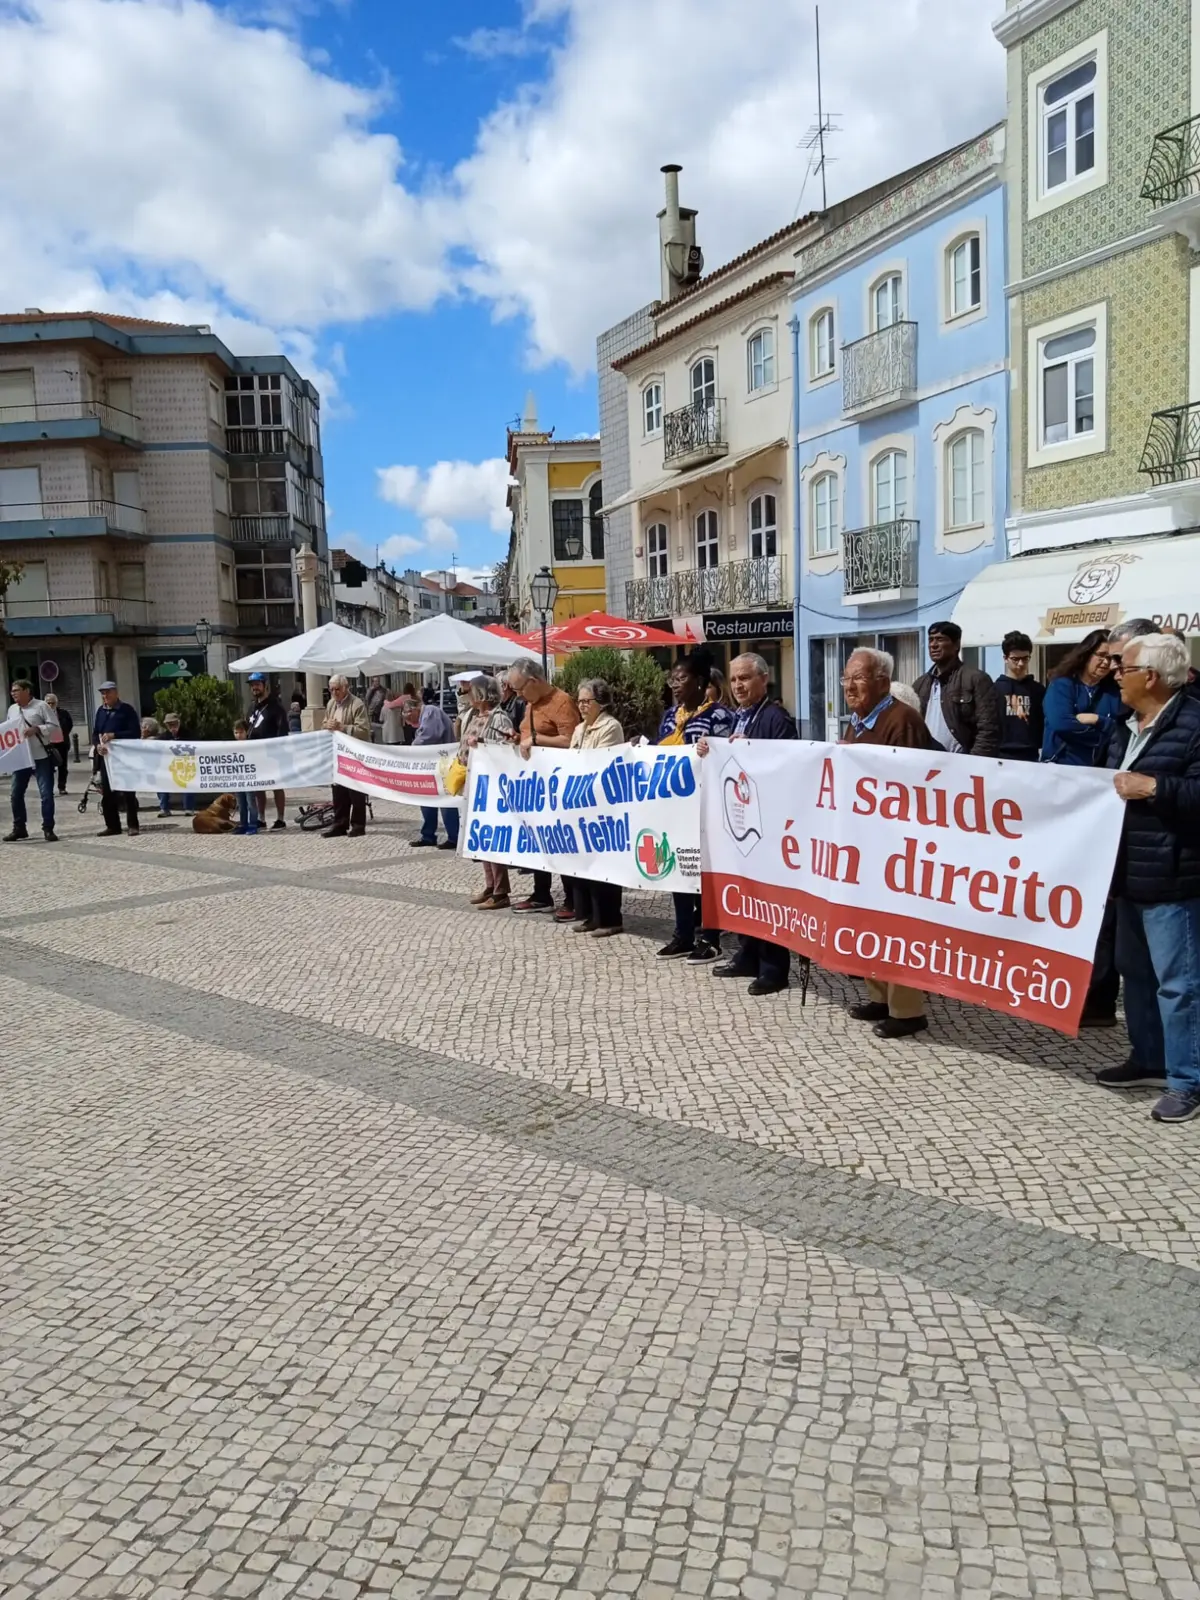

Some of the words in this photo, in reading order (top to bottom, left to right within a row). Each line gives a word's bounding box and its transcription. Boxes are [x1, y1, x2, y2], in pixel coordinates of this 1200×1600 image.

[1050, 607, 1110, 625] Homebread
[705, 618, 795, 635] Restaurante
[198, 752, 245, 765] COMISSÃO
[387, 759, 412, 770] NACIONAL
[411, 762, 419, 770] DE
[420, 760, 437, 771] SAÚDE
[200, 765, 213, 775] DE
[214, 763, 257, 775] UTENTES
[246, 779, 276, 787] ALENQUER
[472, 774, 489, 812] A
[497, 770, 545, 814] Saúde
[549, 766, 562, 811] é
[562, 771, 599, 810] um
[600, 753, 697, 805] direito
[815, 757, 837, 811] A
[852, 769, 1023, 839] saúde
[467, 818, 513, 853] Sem
[536, 818, 580, 855] nada
[578, 811, 631, 854] feito!
[781, 819, 801, 870] é
[810, 837, 860, 885] um
[884, 836, 1083, 929] direito
[721, 883, 818, 942] Cumpra-se
[833, 926, 1072, 1009] constituição
